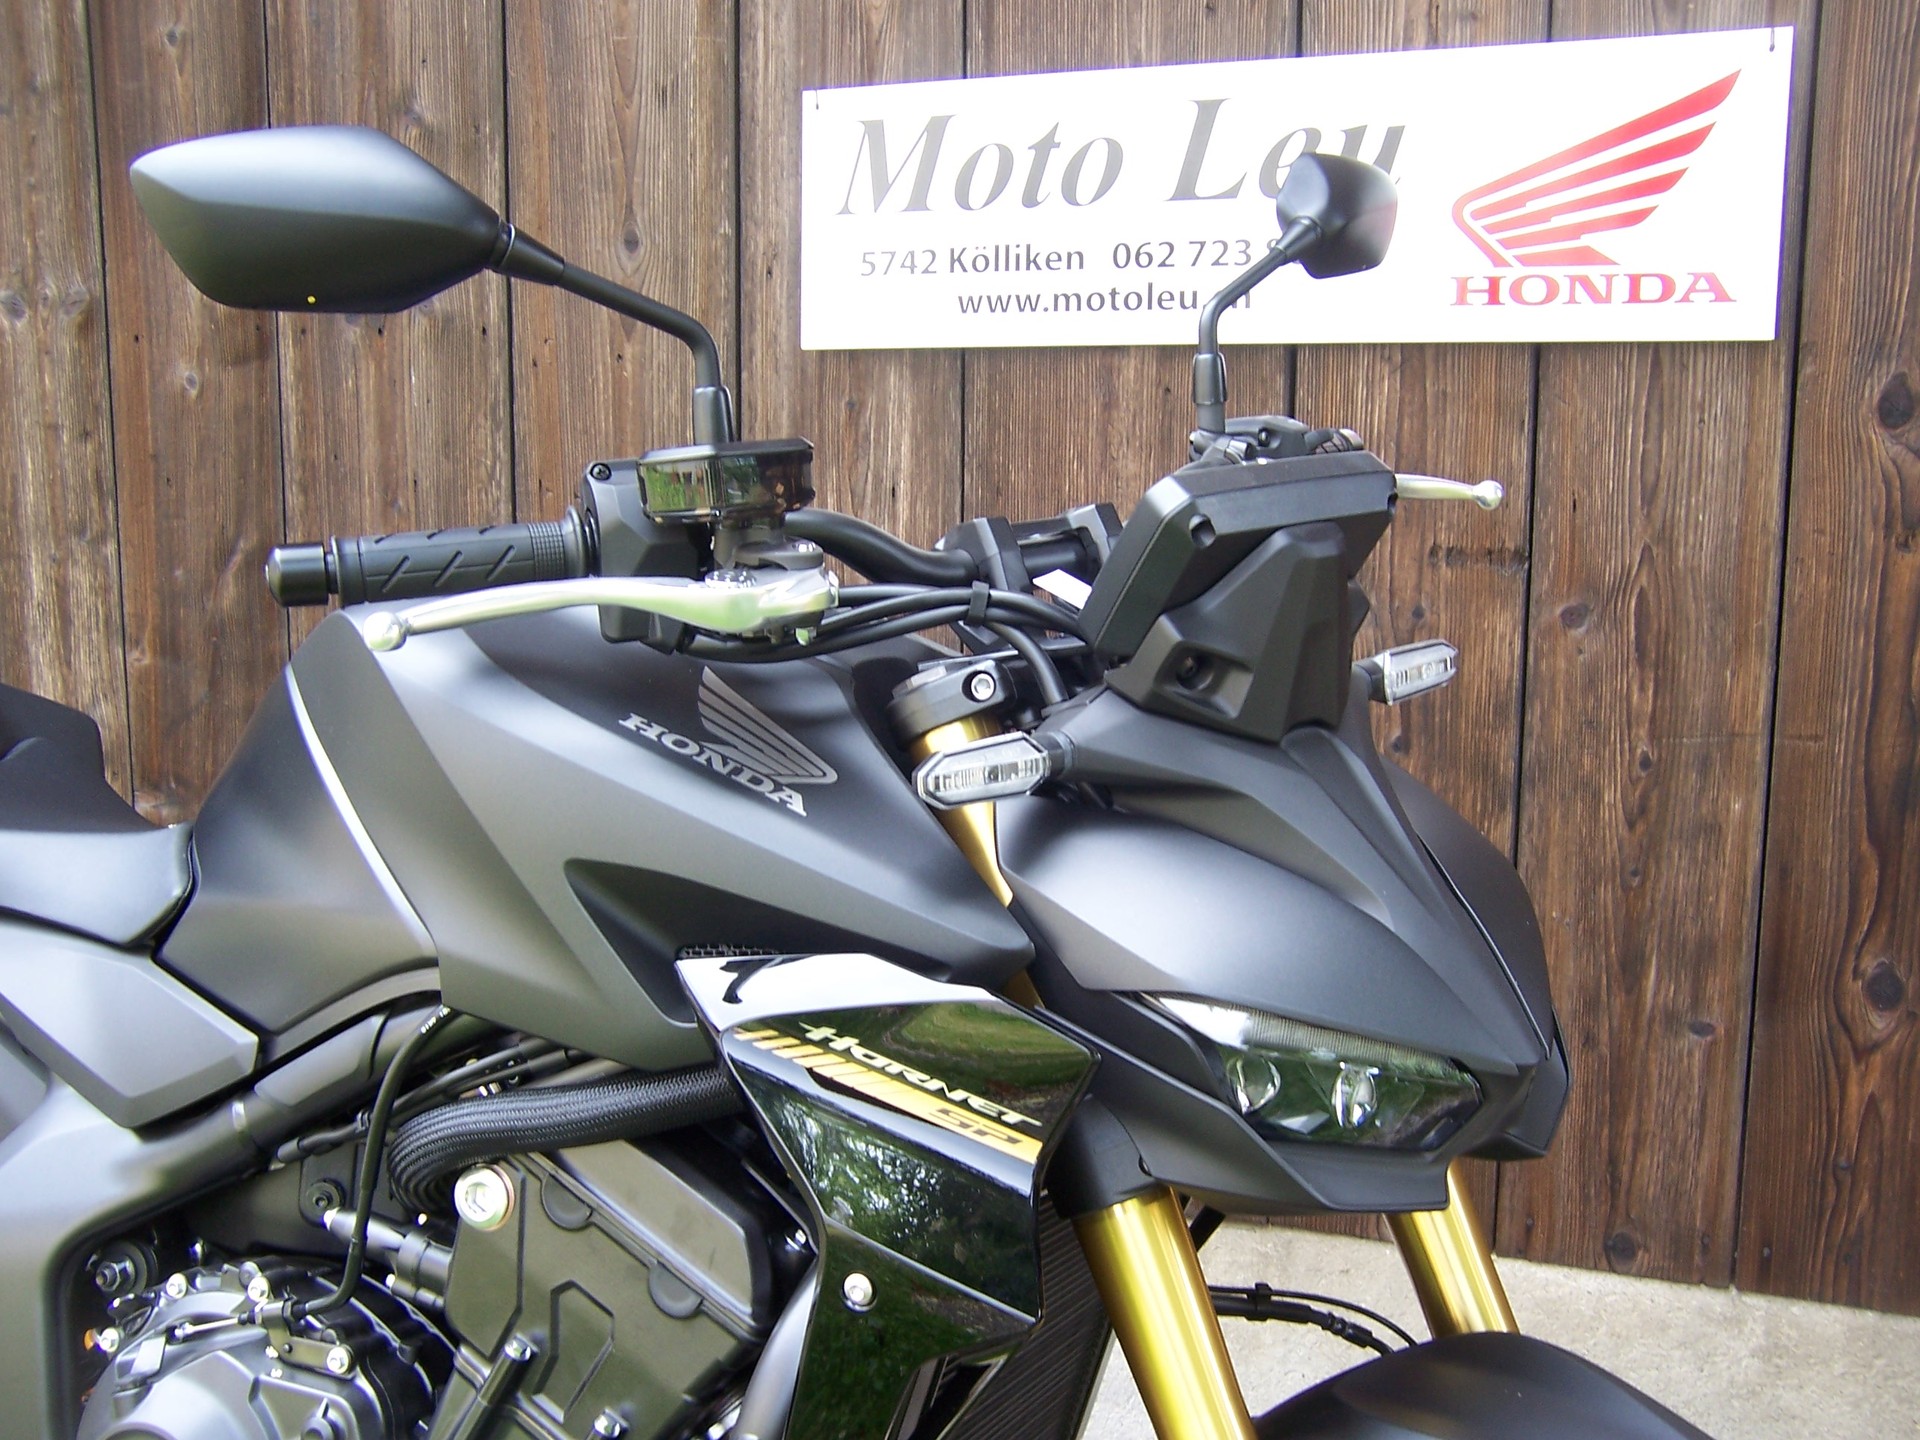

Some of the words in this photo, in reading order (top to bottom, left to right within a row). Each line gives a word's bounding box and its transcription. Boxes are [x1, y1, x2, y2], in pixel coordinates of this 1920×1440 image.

[836, 115, 1124, 216] Moto
[860, 251, 937, 275] 5742
[949, 243, 1085, 273] Kölliken
[1112, 241, 1175, 268] 062
[1189, 239, 1252, 266] 723
[1451, 273, 1736, 305] HONDA
[957, 282, 1251, 313] www.motoleu
[618, 712, 808, 817] HONDA
[799, 1021, 1043, 1127] HORNET
